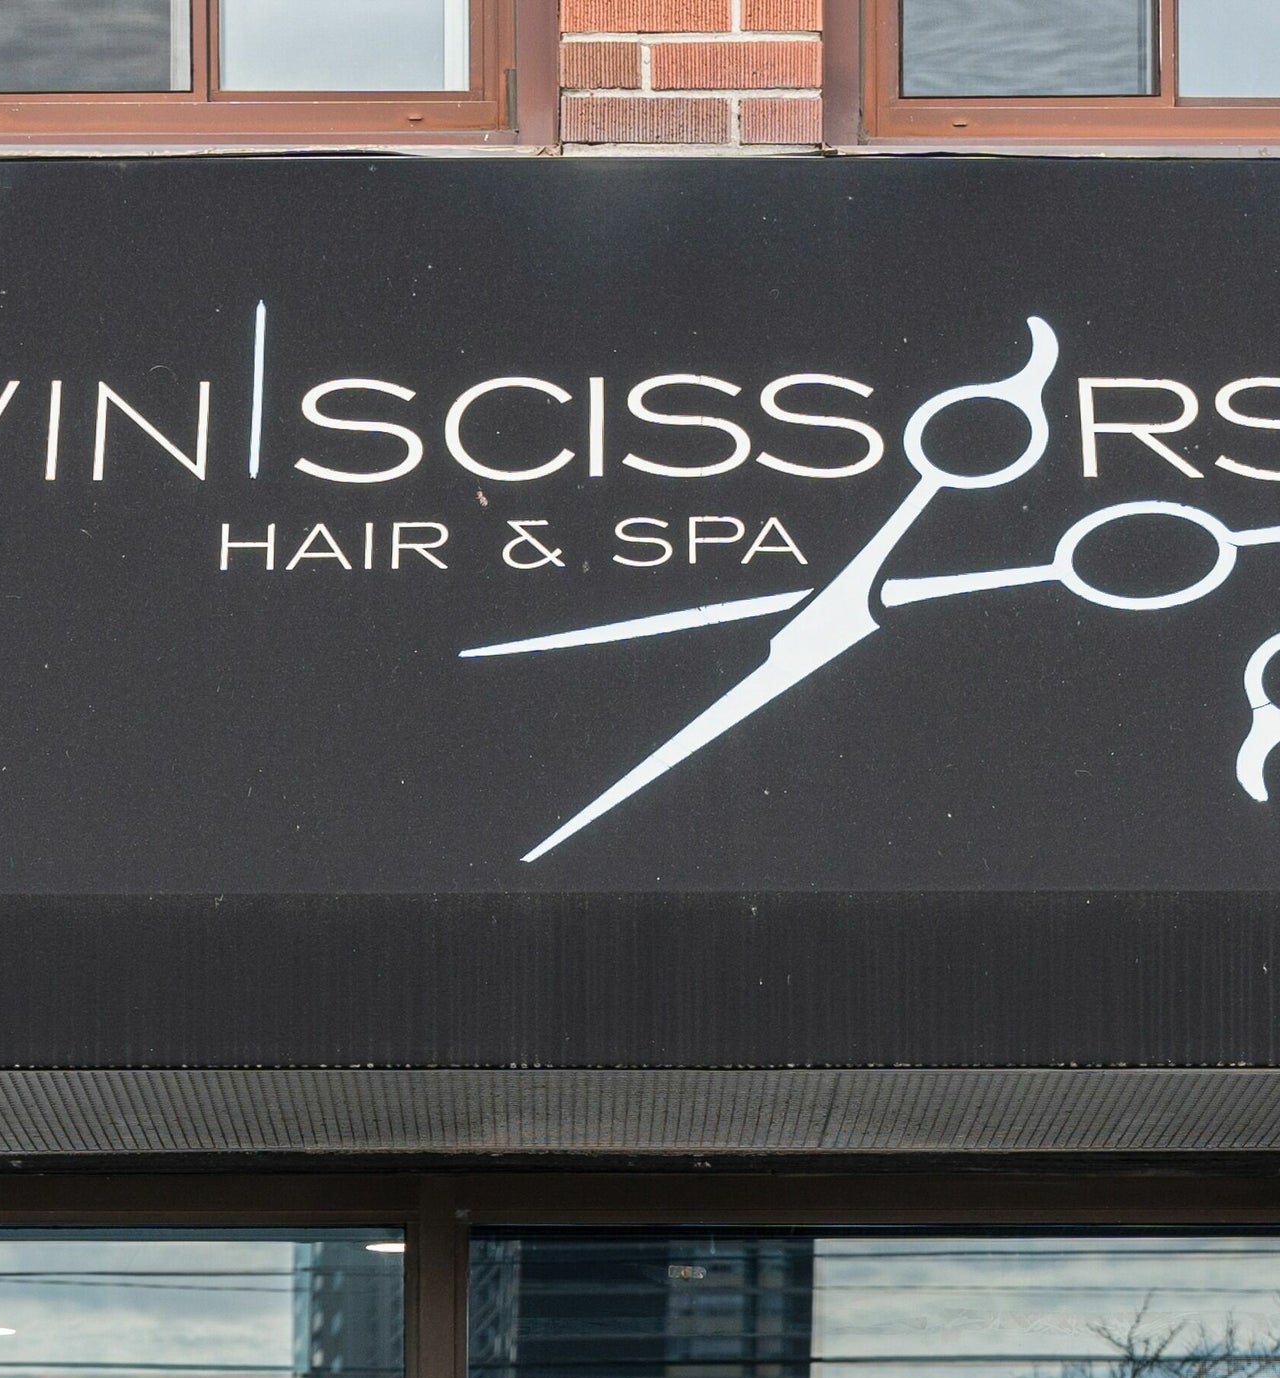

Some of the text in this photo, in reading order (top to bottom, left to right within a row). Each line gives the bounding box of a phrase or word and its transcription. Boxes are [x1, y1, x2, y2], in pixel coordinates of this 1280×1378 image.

[219, 515, 809, 572] HAIR & SPA
